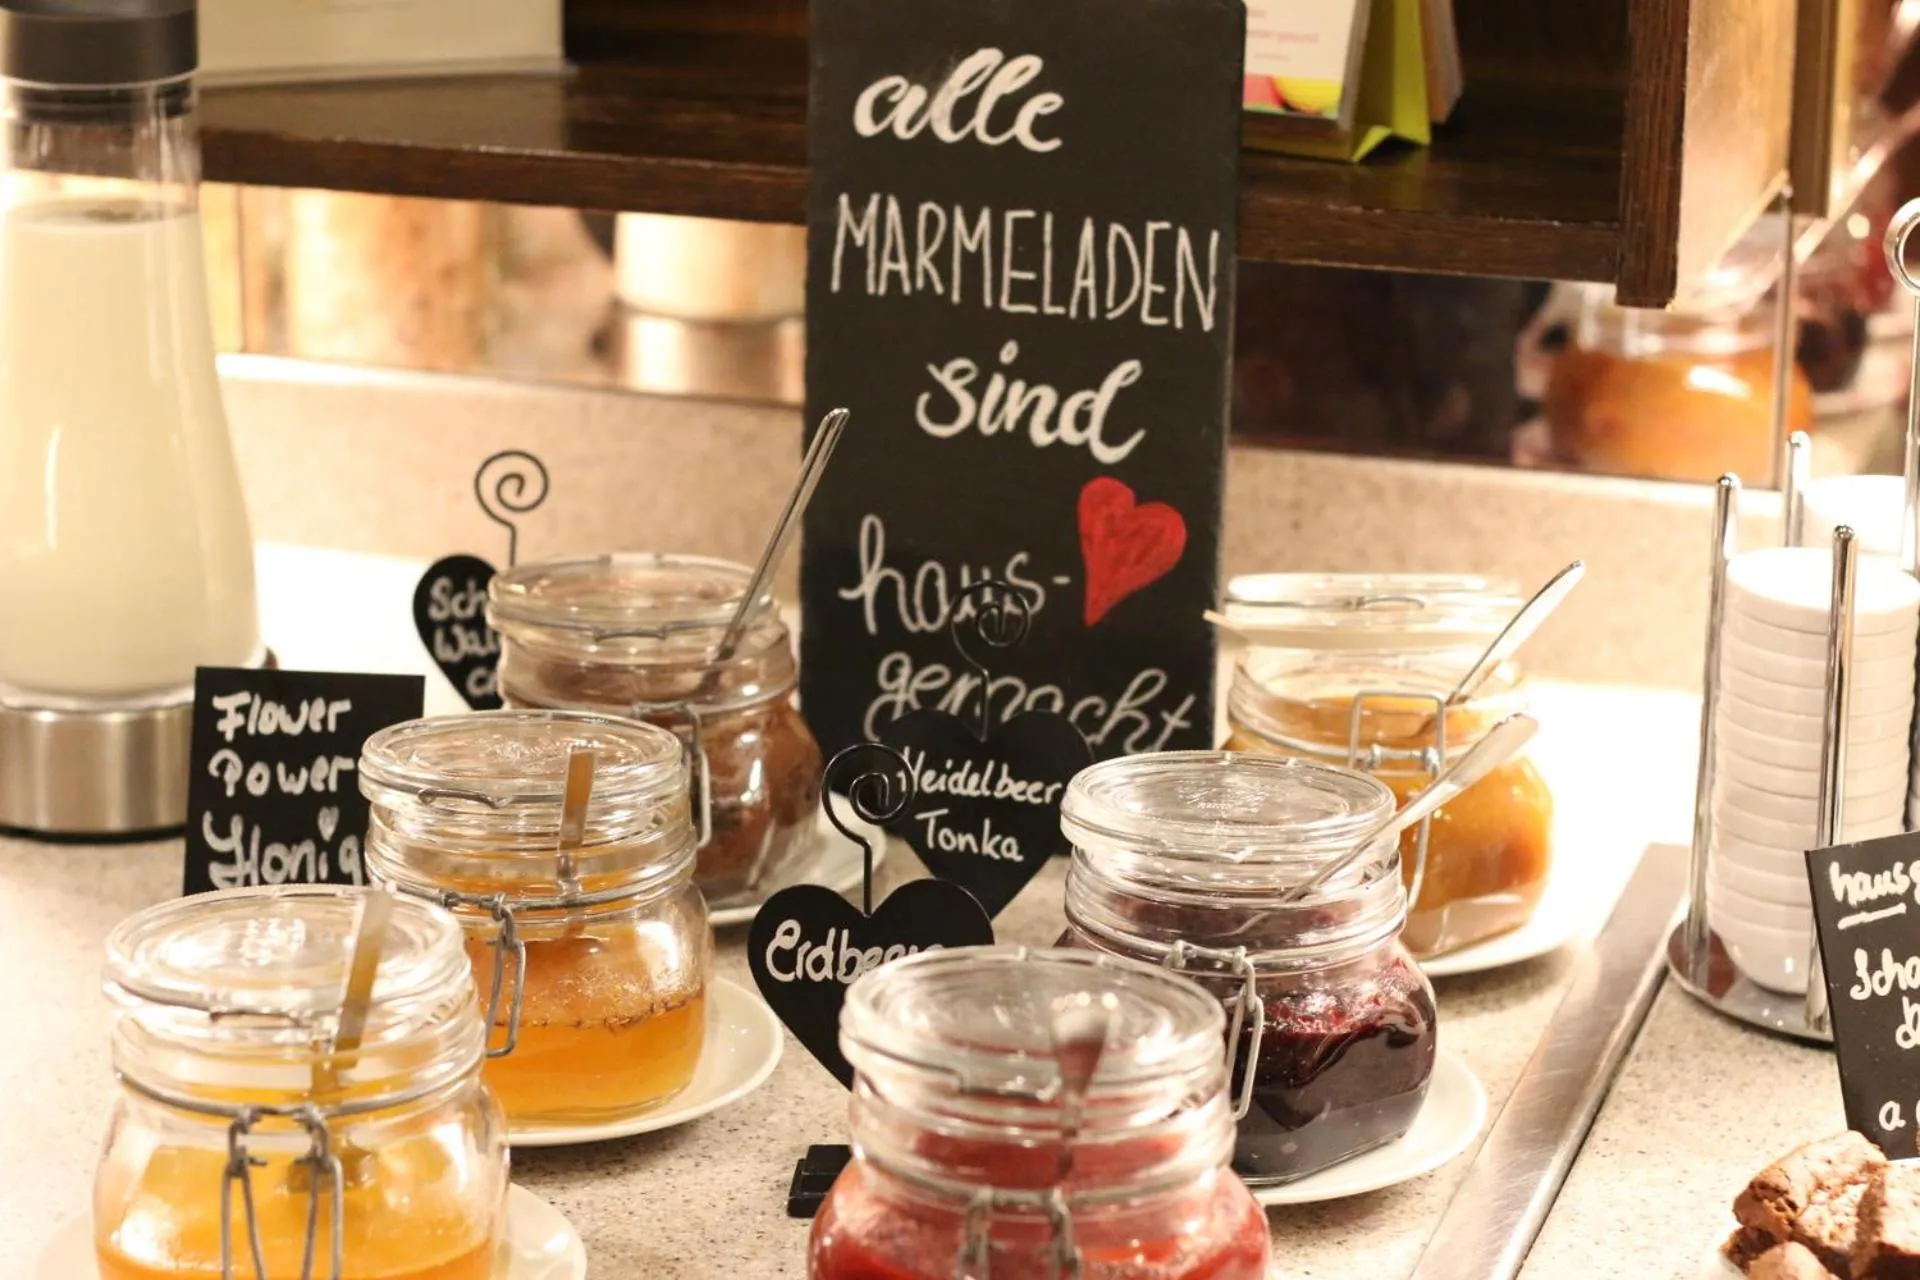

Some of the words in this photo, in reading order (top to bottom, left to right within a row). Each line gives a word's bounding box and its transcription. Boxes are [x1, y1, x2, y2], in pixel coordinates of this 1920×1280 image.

[853, 47, 1064, 152] alle
[831, 192, 1219, 332] MARMELADEN
[915, 340, 1146, 464] sind
[212, 691, 351, 741] Flower
[208, 750, 355, 797] Power
[916, 809, 1024, 862] Tonka
[766, 919, 944, 984] Erdbe
